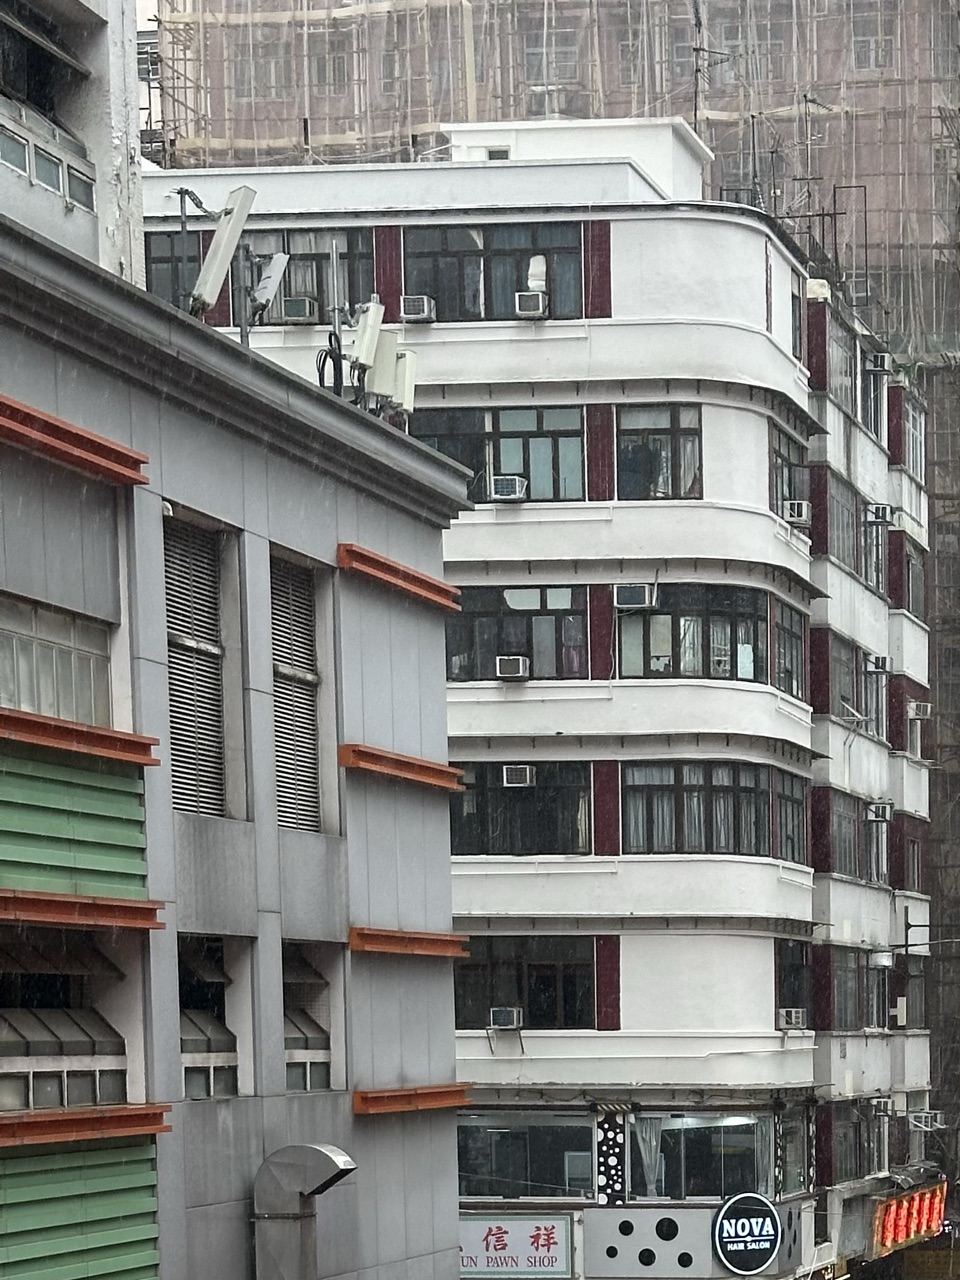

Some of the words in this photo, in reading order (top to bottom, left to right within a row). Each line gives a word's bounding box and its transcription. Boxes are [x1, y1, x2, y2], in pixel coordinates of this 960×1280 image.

[722, 1217, 775, 1238] NOVA
[459, 1224, 558, 1253] 信祥
[727, 1242, 745, 1251] HAIR
[746, 1241, 771, 1250] SALON
[486, 1256, 519, 1267] PAWN
[527, 1256, 557, 1267] SHOP
